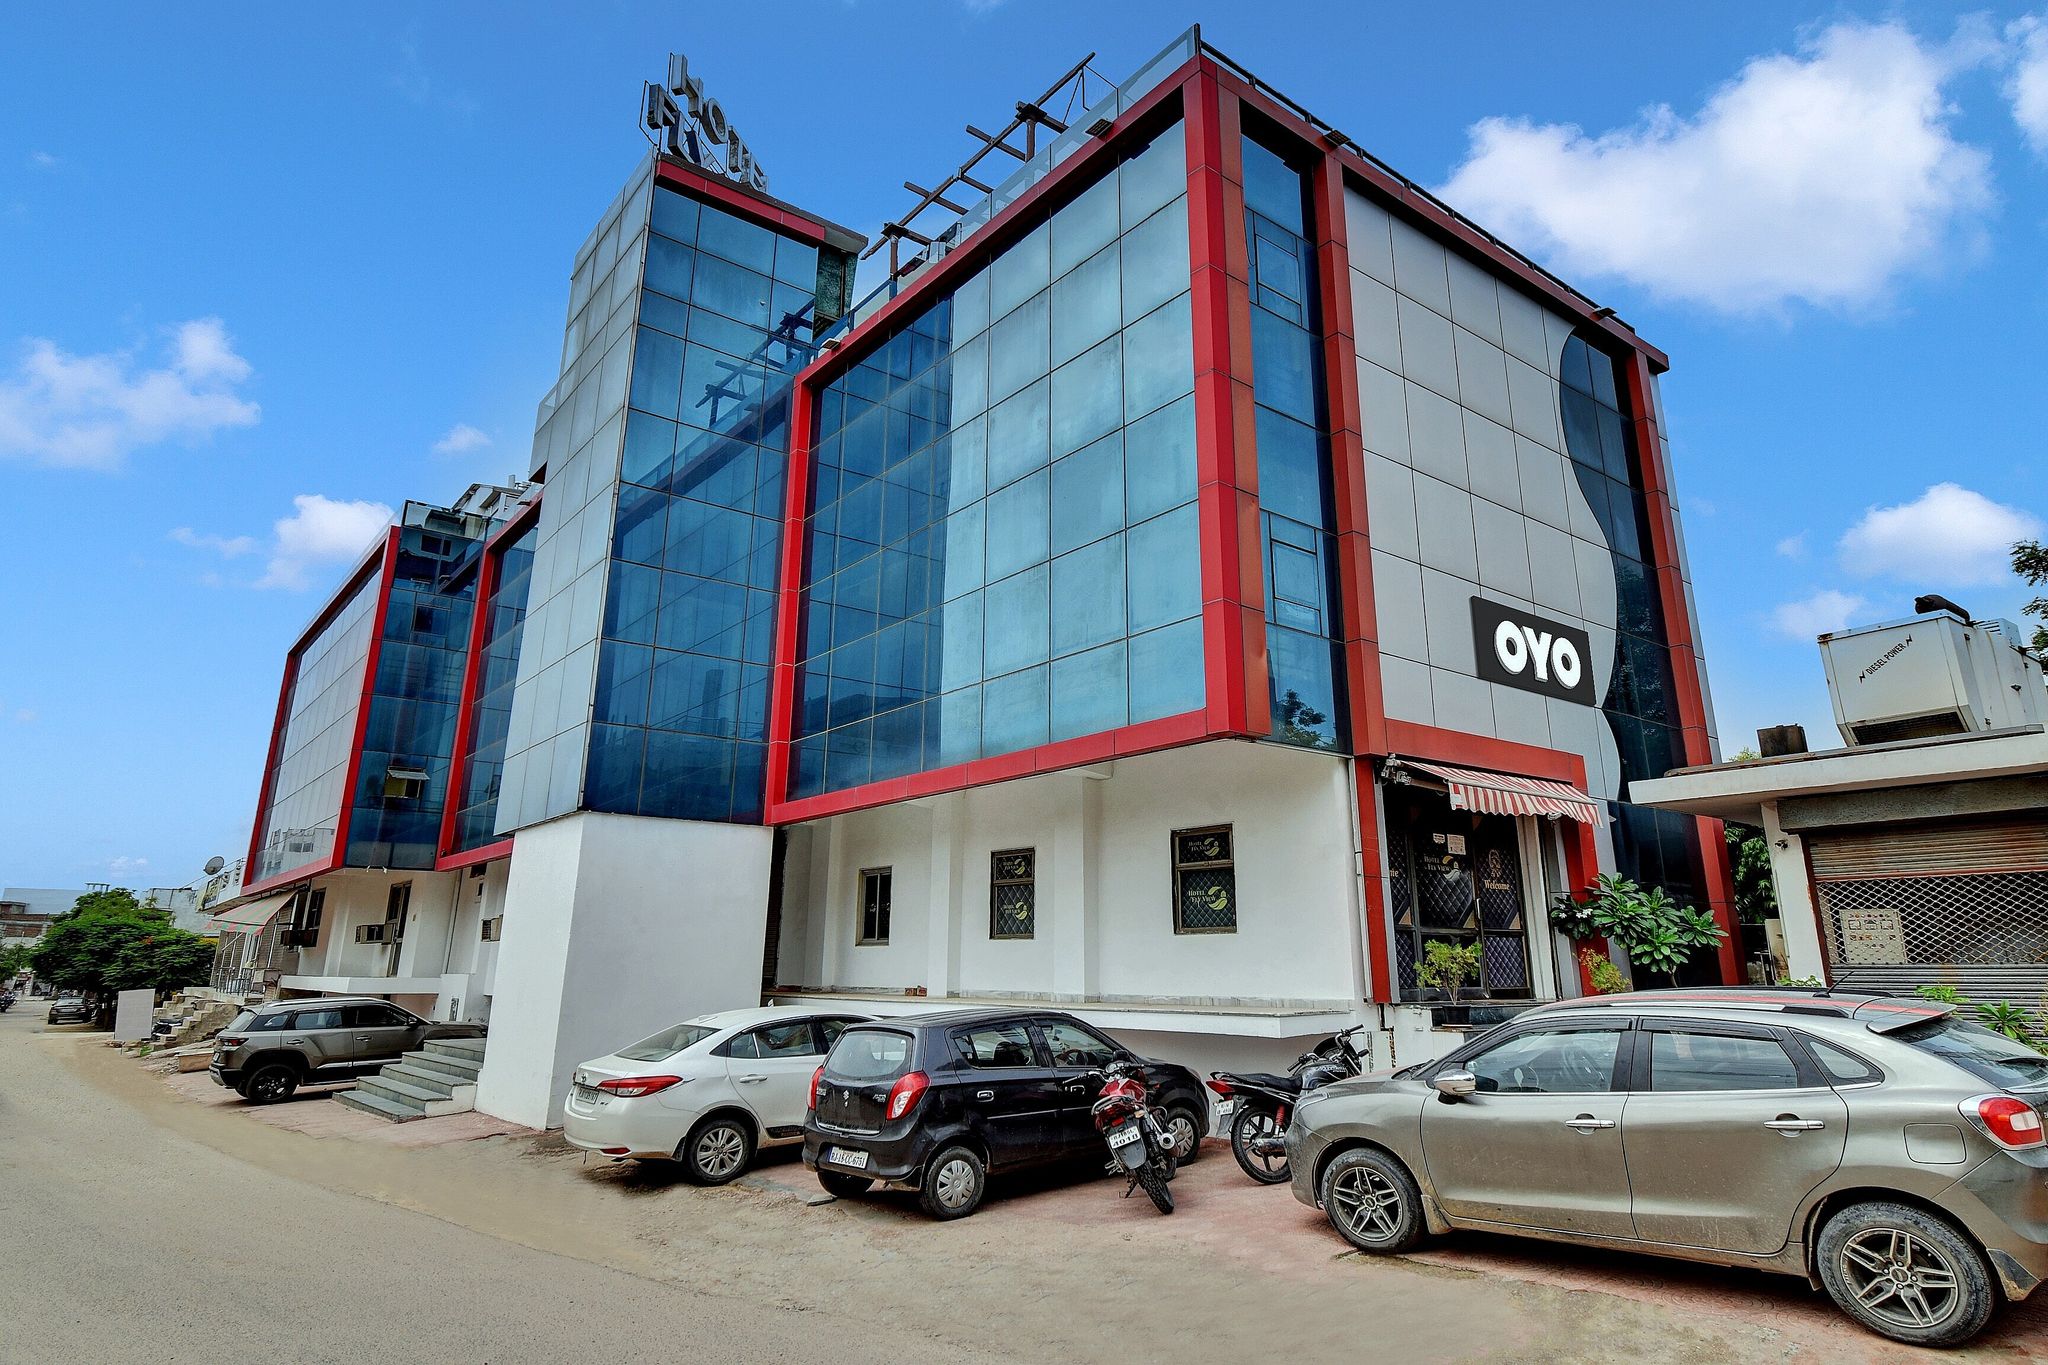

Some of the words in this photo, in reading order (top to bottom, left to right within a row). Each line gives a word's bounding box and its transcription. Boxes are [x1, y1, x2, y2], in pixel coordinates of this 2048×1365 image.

[1493, 620, 1582, 690] OYO
[1865, 658, 1887, 675] DIESEL
[1885, 643, 1906, 660] POWER
[1484, 879, 1510, 891] Welcome
